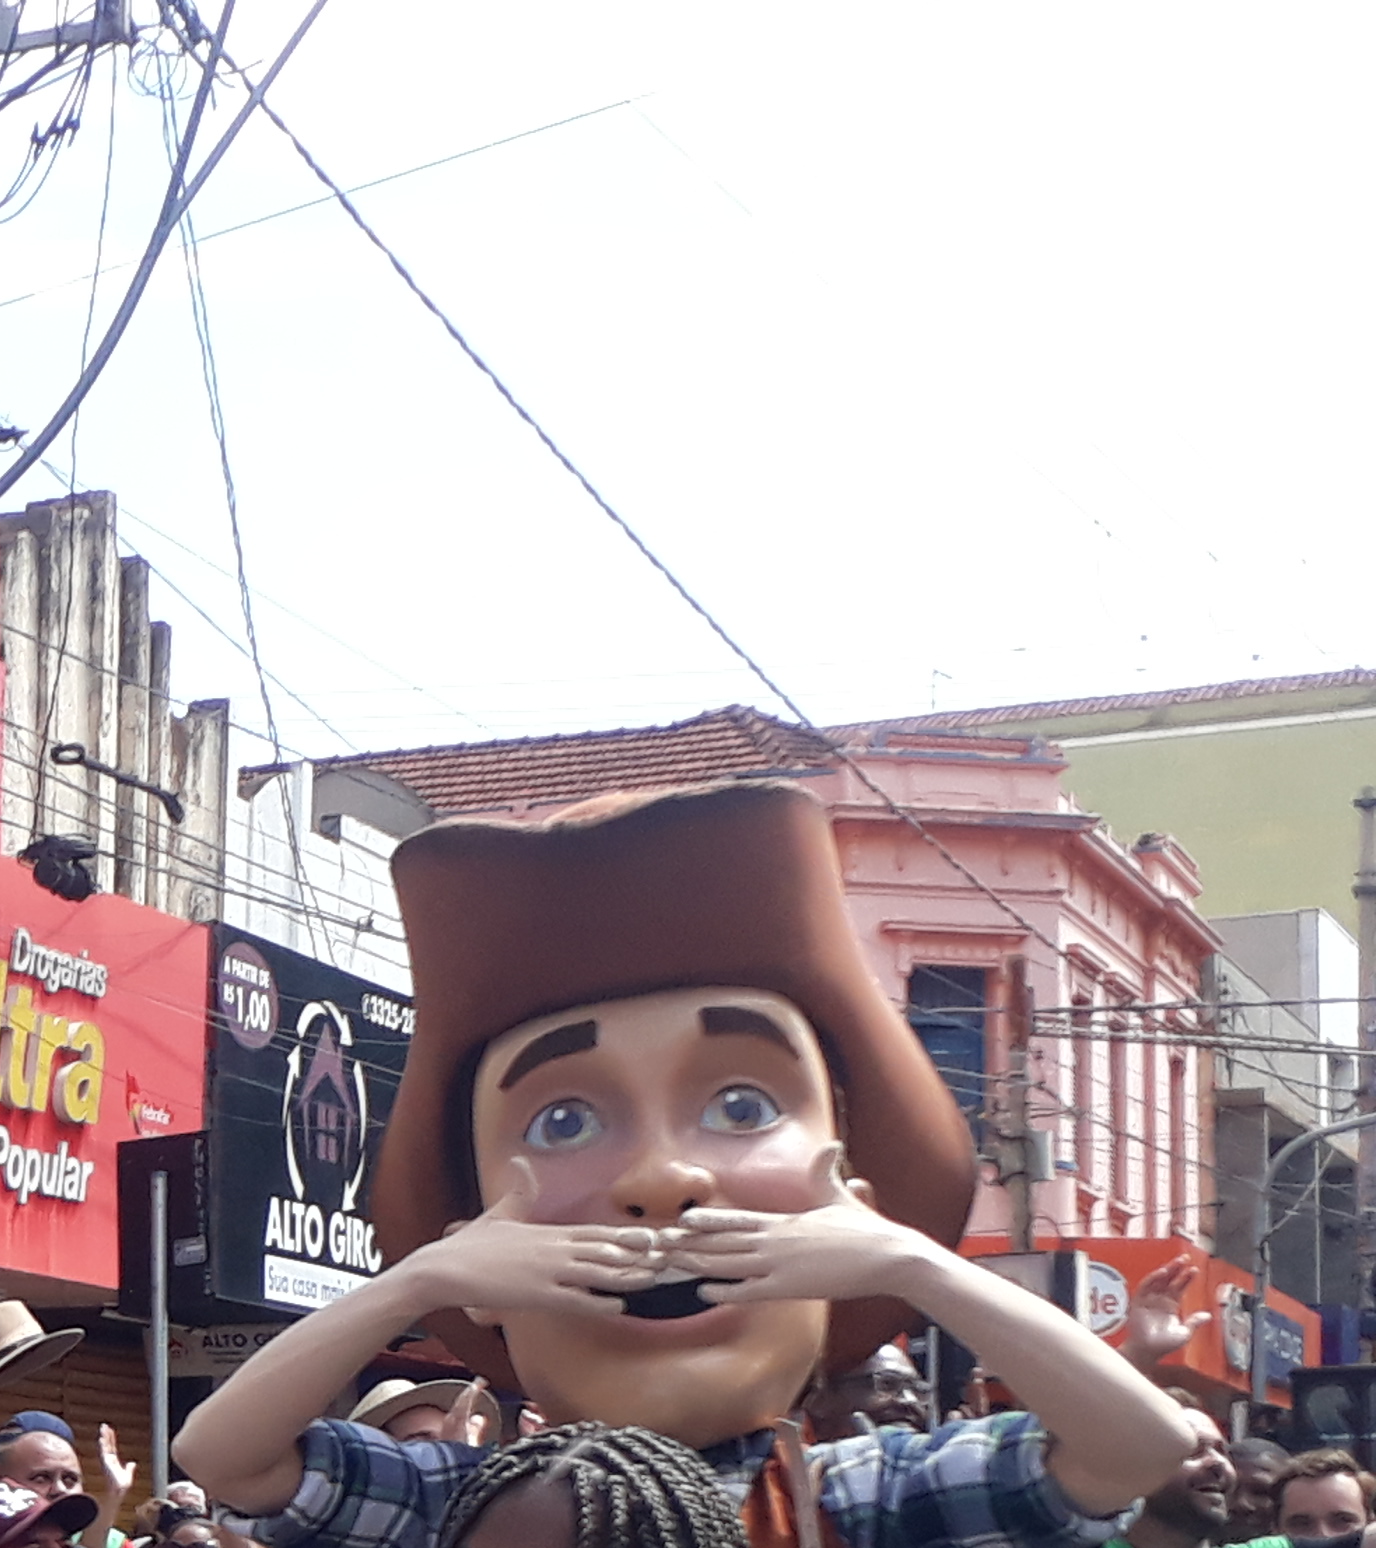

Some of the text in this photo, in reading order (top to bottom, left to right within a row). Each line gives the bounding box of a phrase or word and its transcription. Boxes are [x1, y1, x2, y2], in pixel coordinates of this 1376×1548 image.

[11, 927, 108, 998] Drogarias
[224, 956, 271, 989] A PARTIR DE
[237, 985, 270, 1032] 1,00
[265, 1196, 324, 1259] ALTO
[268, 1265, 289, 1293] Sua
[292, 1278, 318, 1300] casa
[202, 1333, 248, 1348] ALTO
